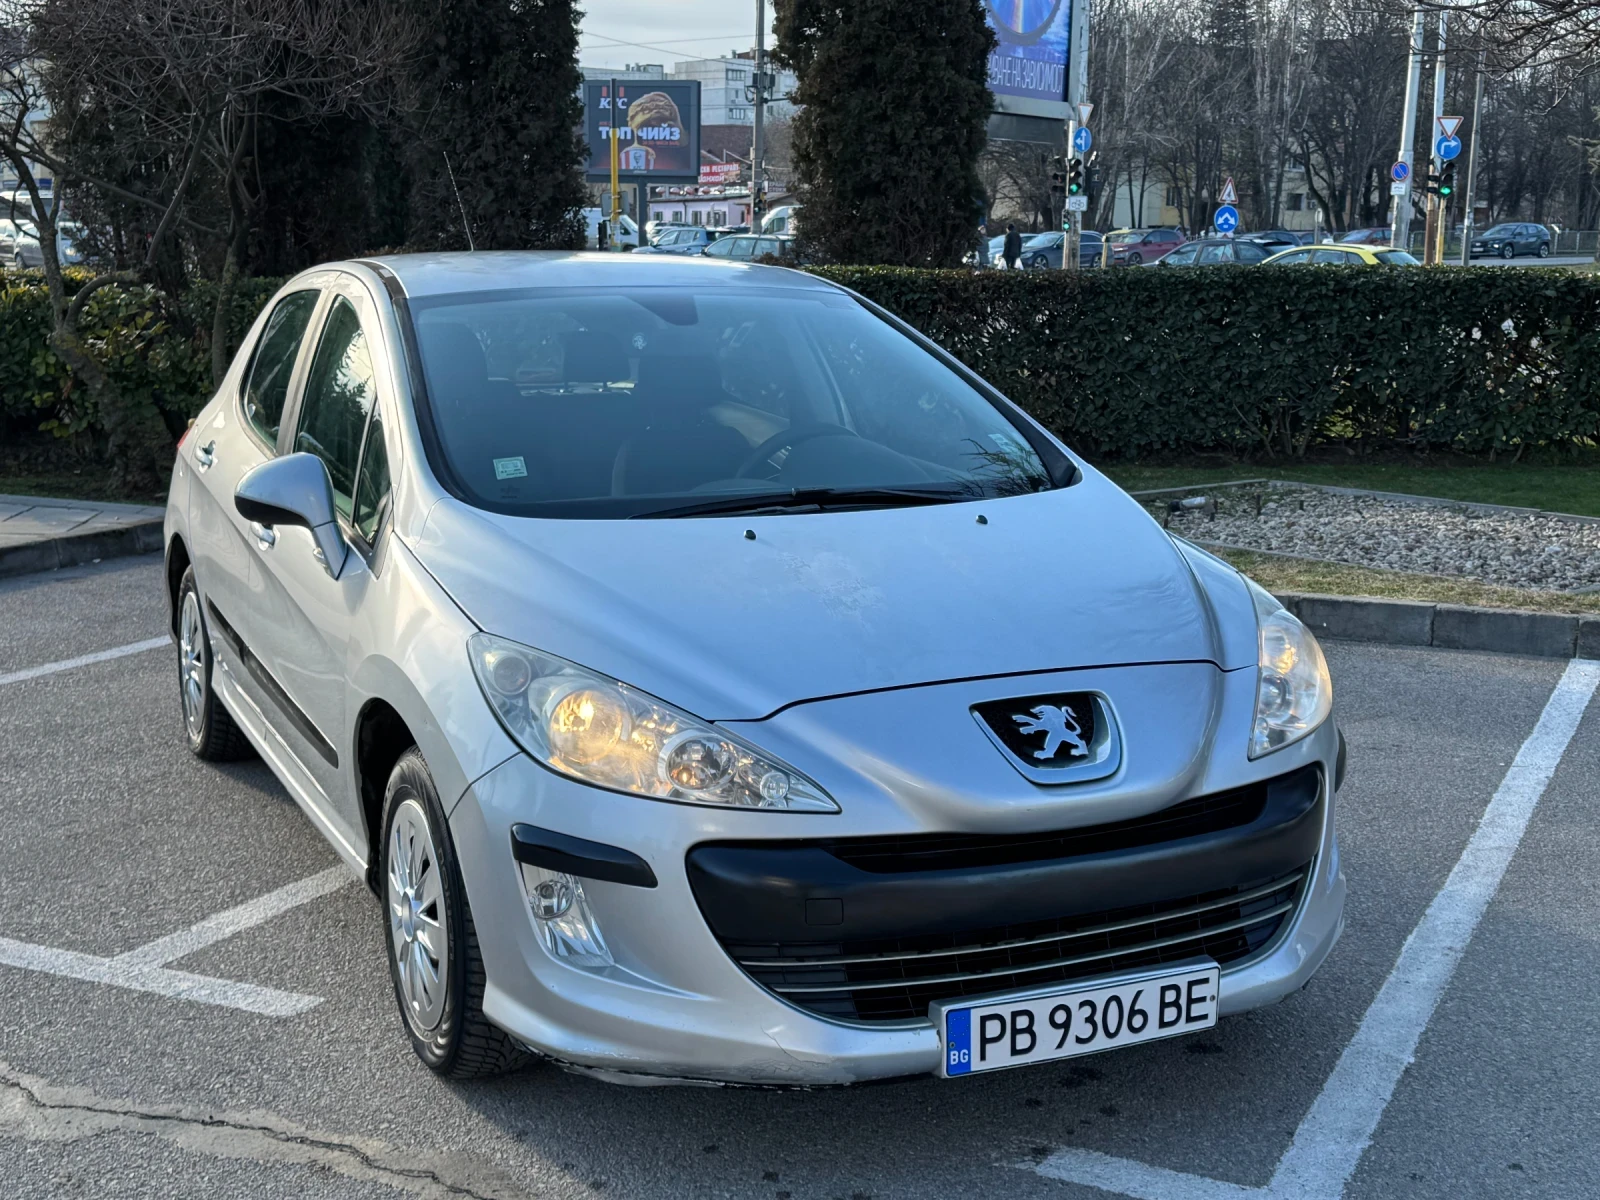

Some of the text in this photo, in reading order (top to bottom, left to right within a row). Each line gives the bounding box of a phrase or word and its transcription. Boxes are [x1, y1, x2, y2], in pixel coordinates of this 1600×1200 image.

[598, 97, 628, 109] KC
[637, 123, 681, 141] ЧИЙЗ
[979, 977, 1211, 1062] PB 9306 BE
[950, 1049, 969, 1065] BG
